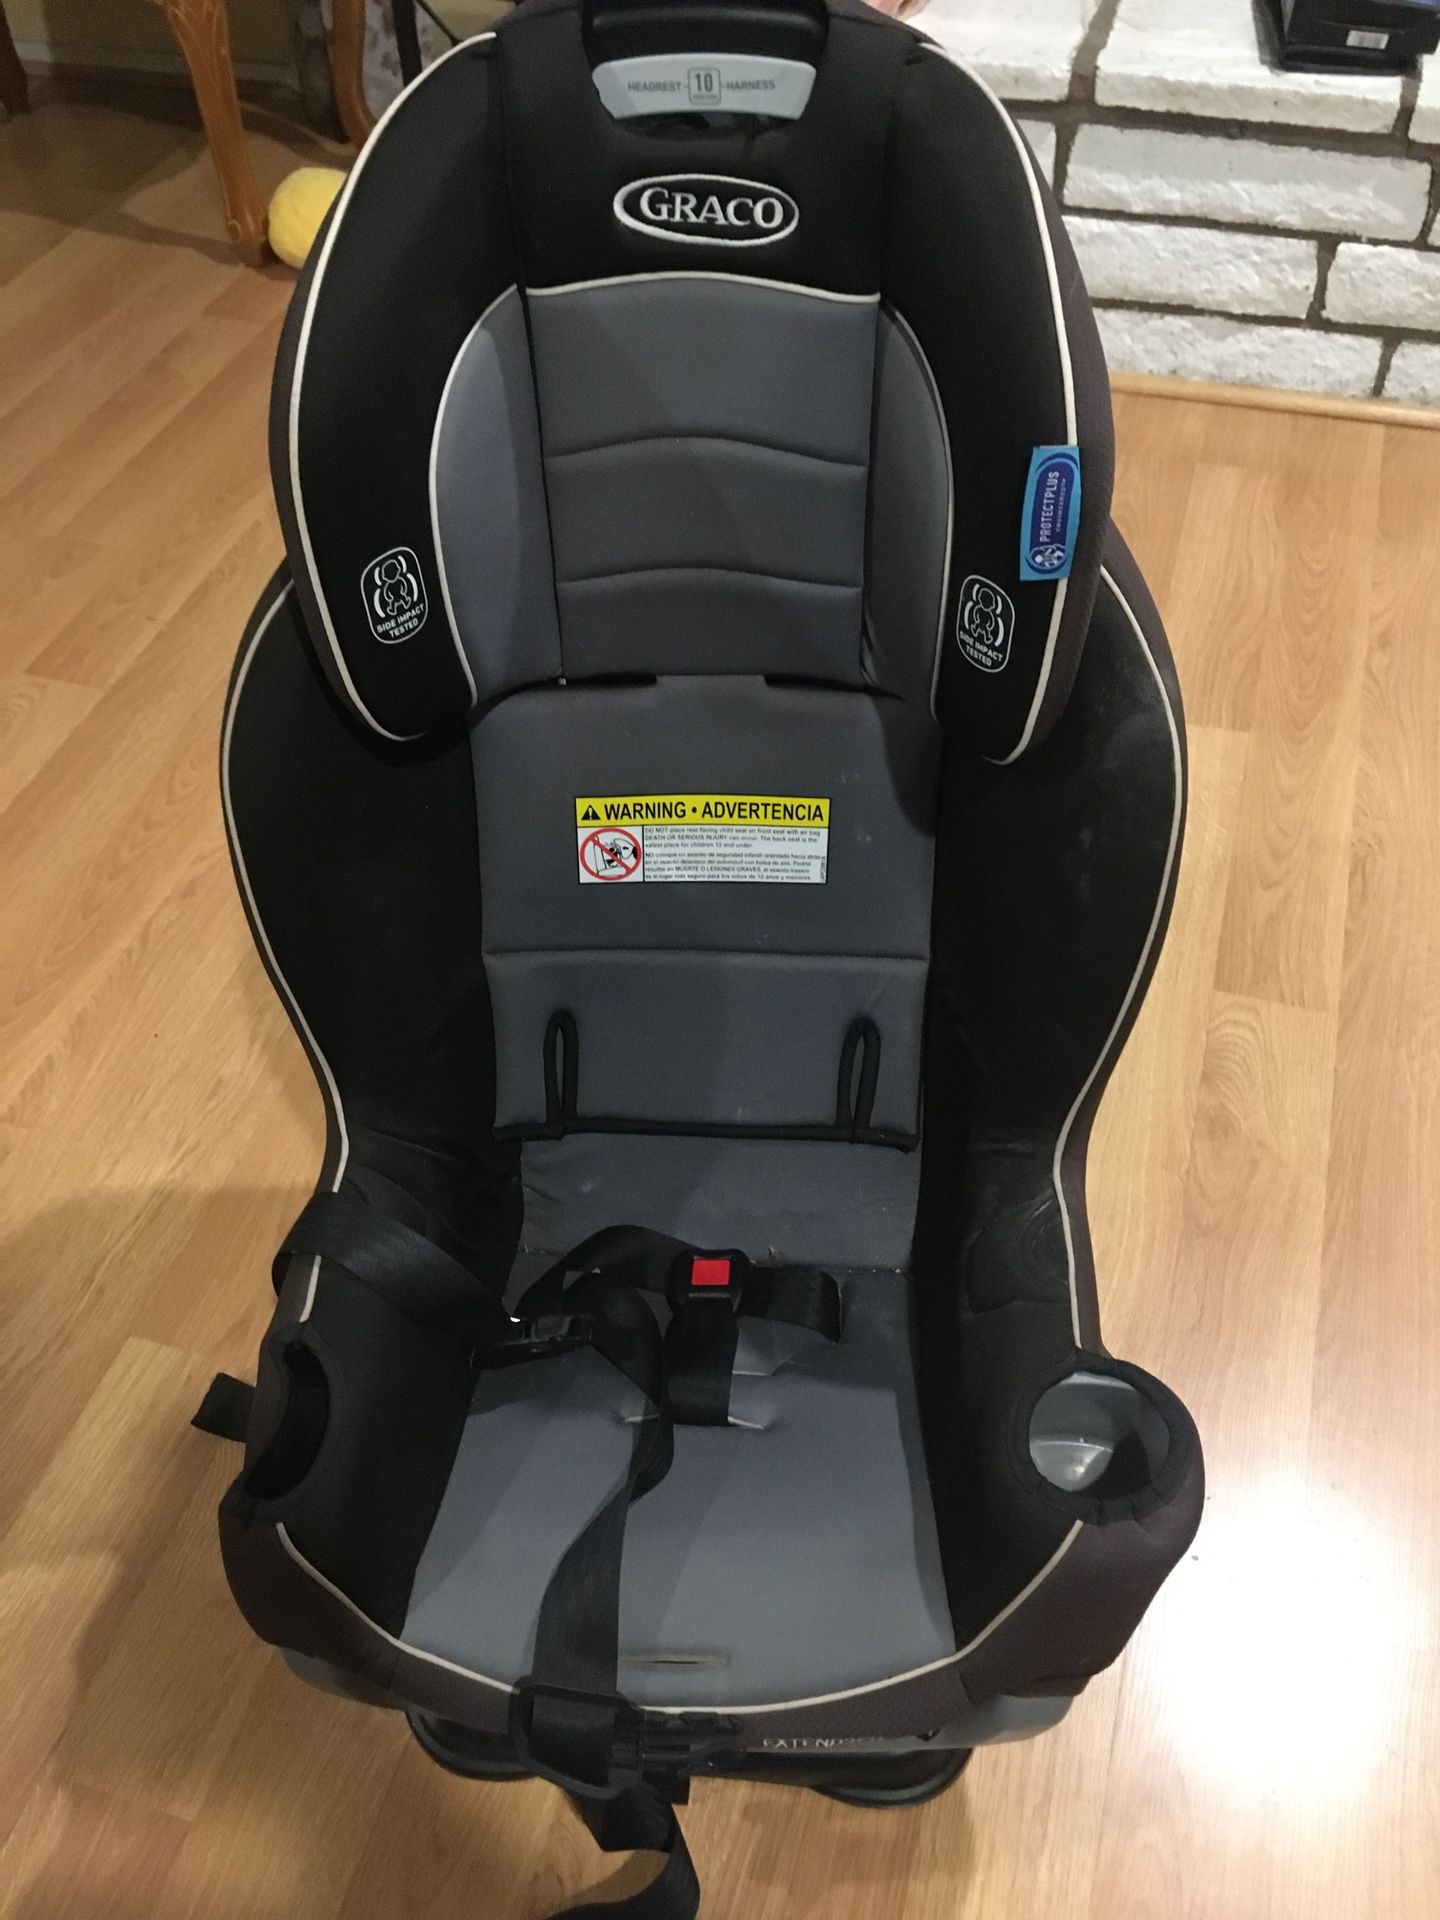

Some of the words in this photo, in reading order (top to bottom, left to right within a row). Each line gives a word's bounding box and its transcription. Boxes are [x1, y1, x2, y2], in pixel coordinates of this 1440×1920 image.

[628, 81, 682, 92] HEADREST
[695, 73, 713, 92] 10
[727, 80, 776, 91] HARNESS
[640, 186, 784, 229] GRACO
[1040, 470, 1060, 543] PROTECTPLUS
[377, 619, 397, 634] SIDE
[397, 604, 425, 624] IMPACT
[389, 618, 419, 638] TESTED
[960, 630, 974, 647] SIDE
[975, 639, 1003, 662] IMPACT
[966, 645, 992, 666] TESTED
[604, 801, 687, 820] WARNING
[702, 802, 824, 821] ADVERTENCIA
